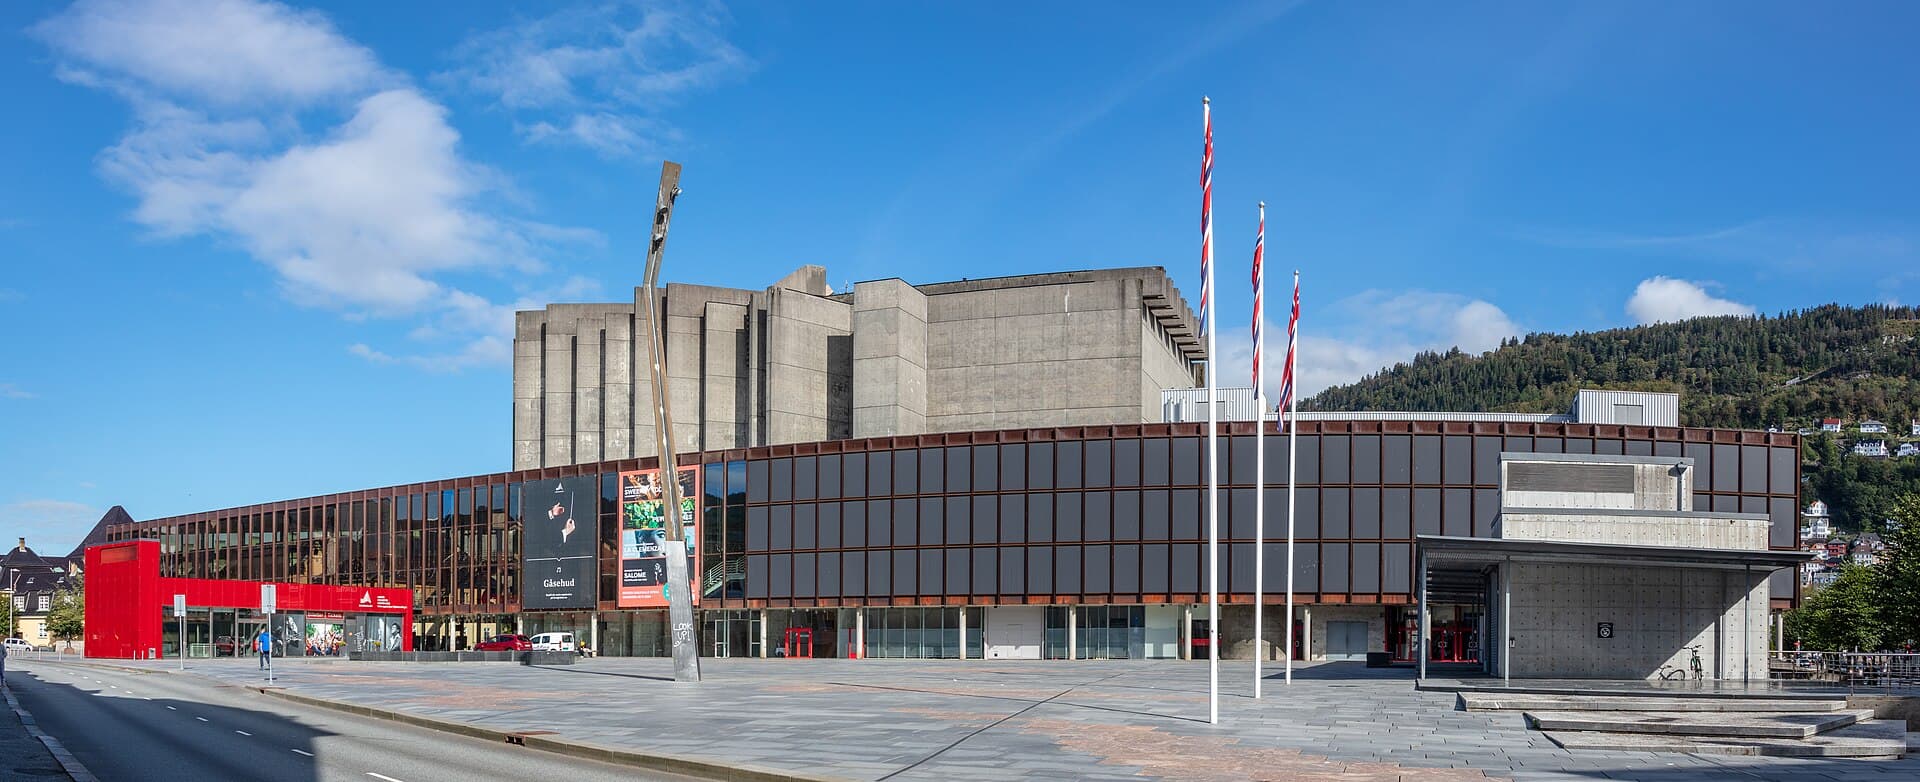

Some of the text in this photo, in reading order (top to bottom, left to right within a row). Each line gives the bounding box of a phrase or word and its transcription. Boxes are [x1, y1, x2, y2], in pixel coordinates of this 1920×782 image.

[543, 577, 575, 588] Gåsehud
[672, 622, 693, 631] LOOK
[677, 630, 691, 642] UP!
